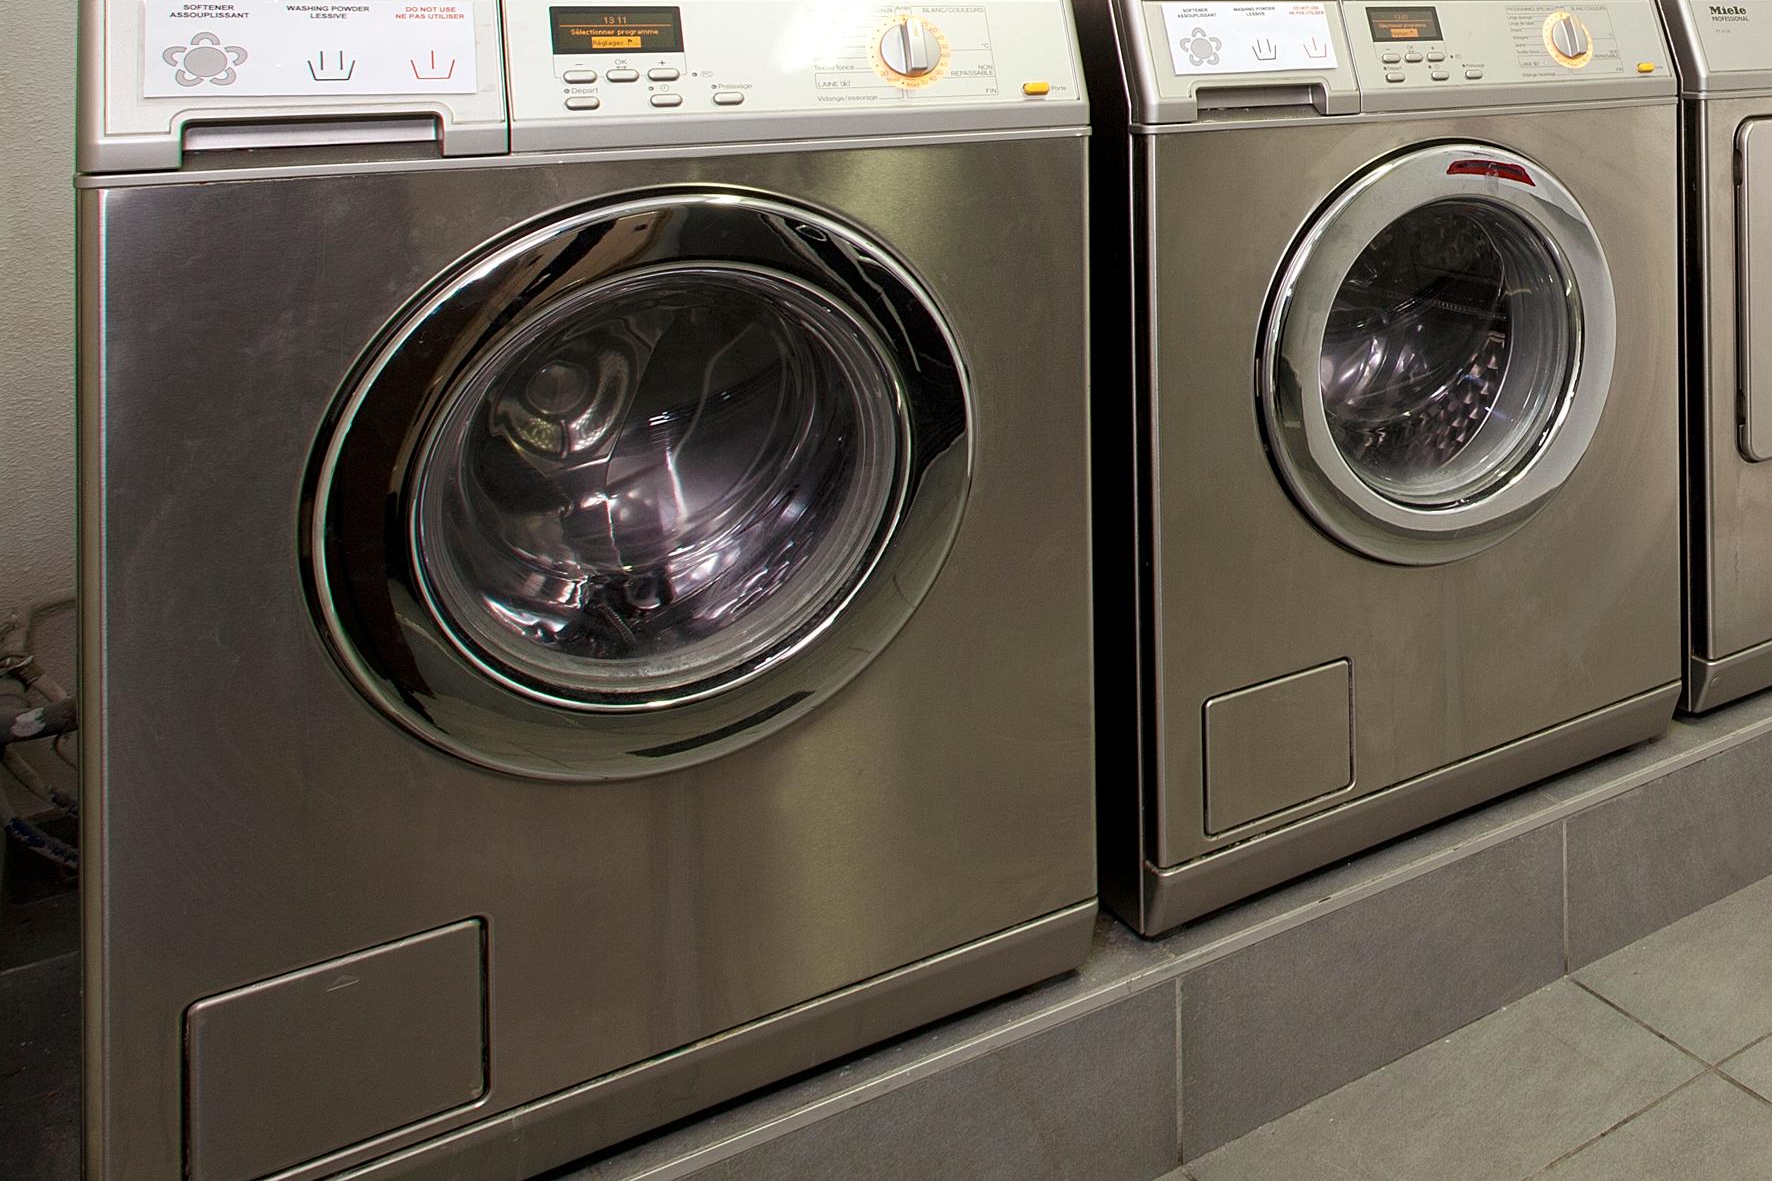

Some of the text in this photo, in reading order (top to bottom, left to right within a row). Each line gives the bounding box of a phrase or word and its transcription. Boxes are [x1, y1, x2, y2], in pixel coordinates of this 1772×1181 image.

[1709, 6, 1747, 15] Miele
[571, 28, 660, 38] Sélectionner programme
